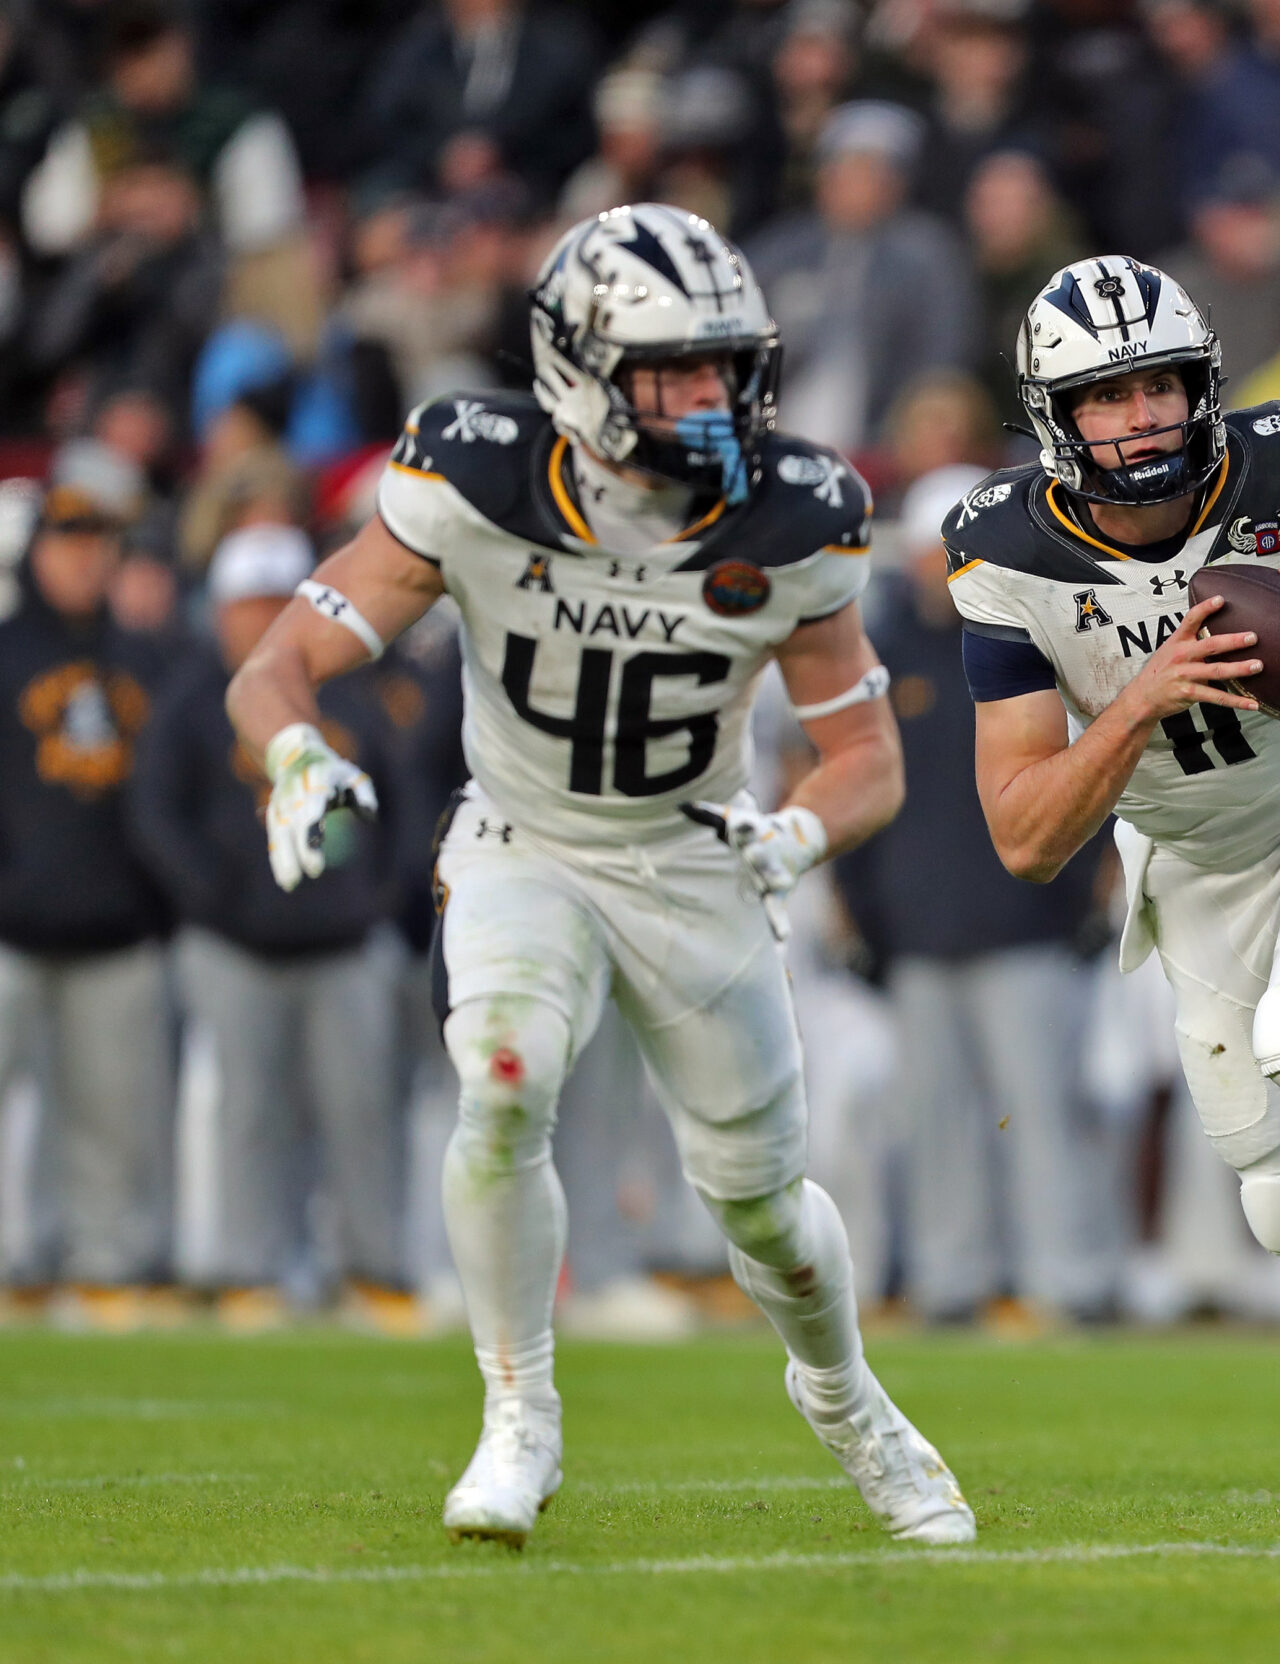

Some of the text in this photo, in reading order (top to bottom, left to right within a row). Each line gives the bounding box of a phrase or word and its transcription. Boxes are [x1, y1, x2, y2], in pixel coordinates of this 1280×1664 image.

[1108, 340, 1147, 361] NAVY
[1133, 464, 1169, 480] Riddell
[554, 598, 686, 643] NAVY
[1117, 611, 1186, 658] NA
[502, 631, 732, 798] 46
